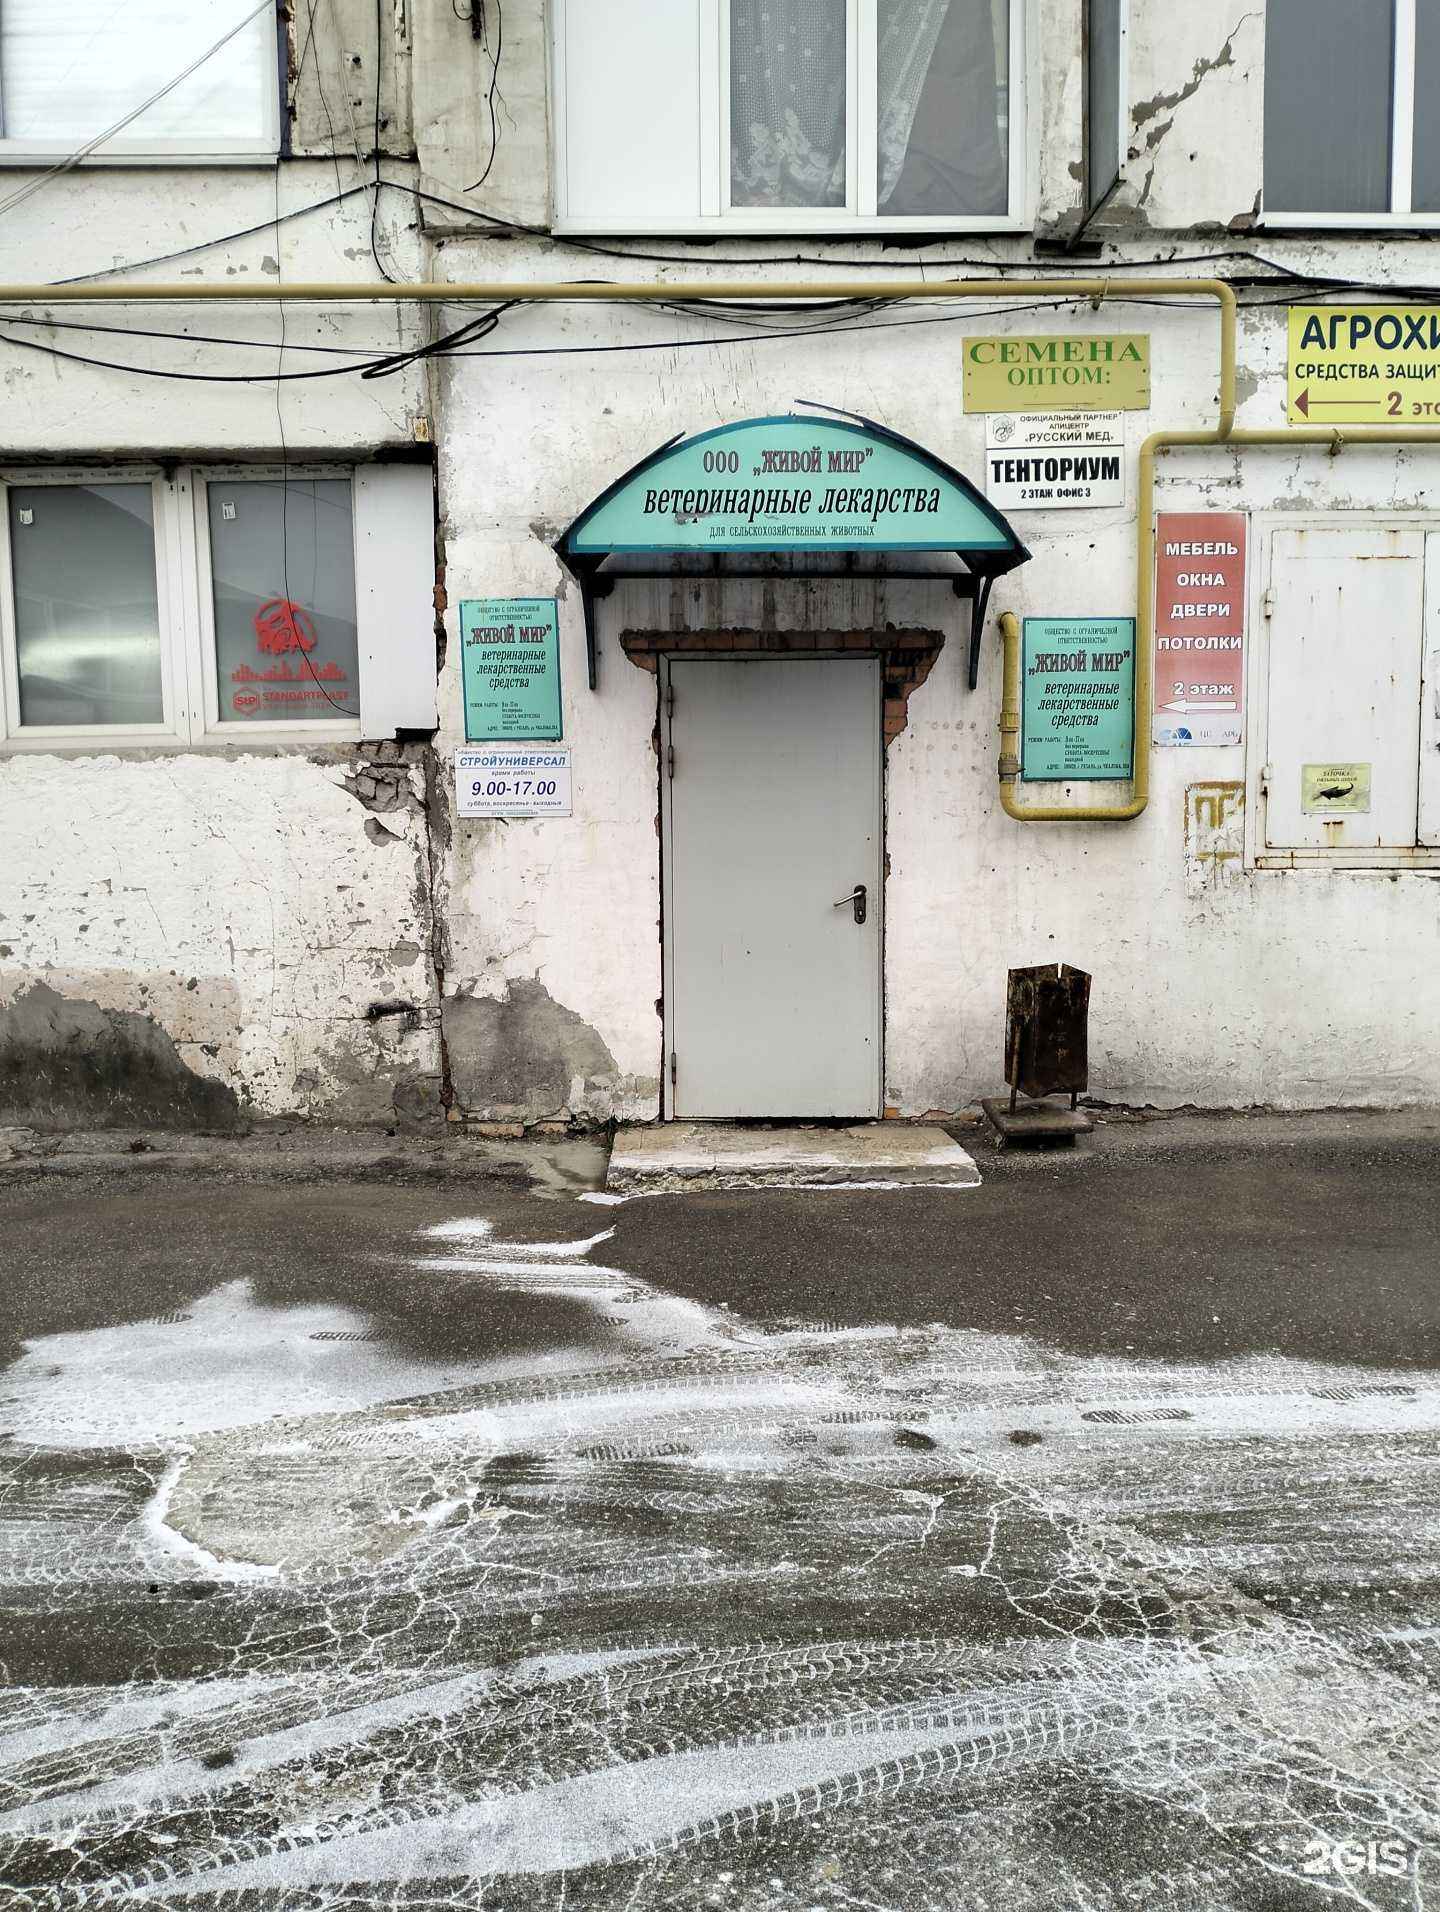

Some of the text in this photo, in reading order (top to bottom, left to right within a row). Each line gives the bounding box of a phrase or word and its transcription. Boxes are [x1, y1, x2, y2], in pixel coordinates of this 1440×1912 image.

[970, 341, 1142, 364] СЕМЕНА
[1008, 367, 1110, 386] ОПТОМ:
[1296, 364, 1380, 380] СРЕДСТВА
[1388, 391, 1402, 416] 2
[1020, 413, 1118, 423] ОФИЦИАЛЬНЫЙ ПАРТНЕР
[703, 450, 739, 473] ООО
[991, 456, 1120, 483] ТЕНТОРИУМ
[1021, 488, 1091, 498] 2 ЭТАЖ ОФИС 3
[643, 487, 940, 522] ветеринарные лекарства
[710, 524, 874, 538] ДЛЯ СЕЛЬСКОХОЗЯЙСТВЕННЫХ ЖИВОТНЫХ
[1166, 542, 1238, 556] МЕБЕЛЬ
[1177, 574, 1226, 587] ОКНА
[1170, 604, 1230, 619] ДВЕРИ
[1158, 636, 1242, 650] ПОТОЛКИ
[481, 650, 546, 664] ветеринарные
[476, 663, 546, 678] лекарственные
[488, 678, 530, 690] средства
[1044, 682, 1120, 698] ветеринарные
[1174, 682, 1234, 696] 2 этаж
[1038, 698, 1120, 713] лекарственные
[1052, 714, 1098, 729] средства
[460, 756, 566, 766] СТРОЙУНИВЕРСАЛ
[472, 781, 556, 796] 9.00-17.00
